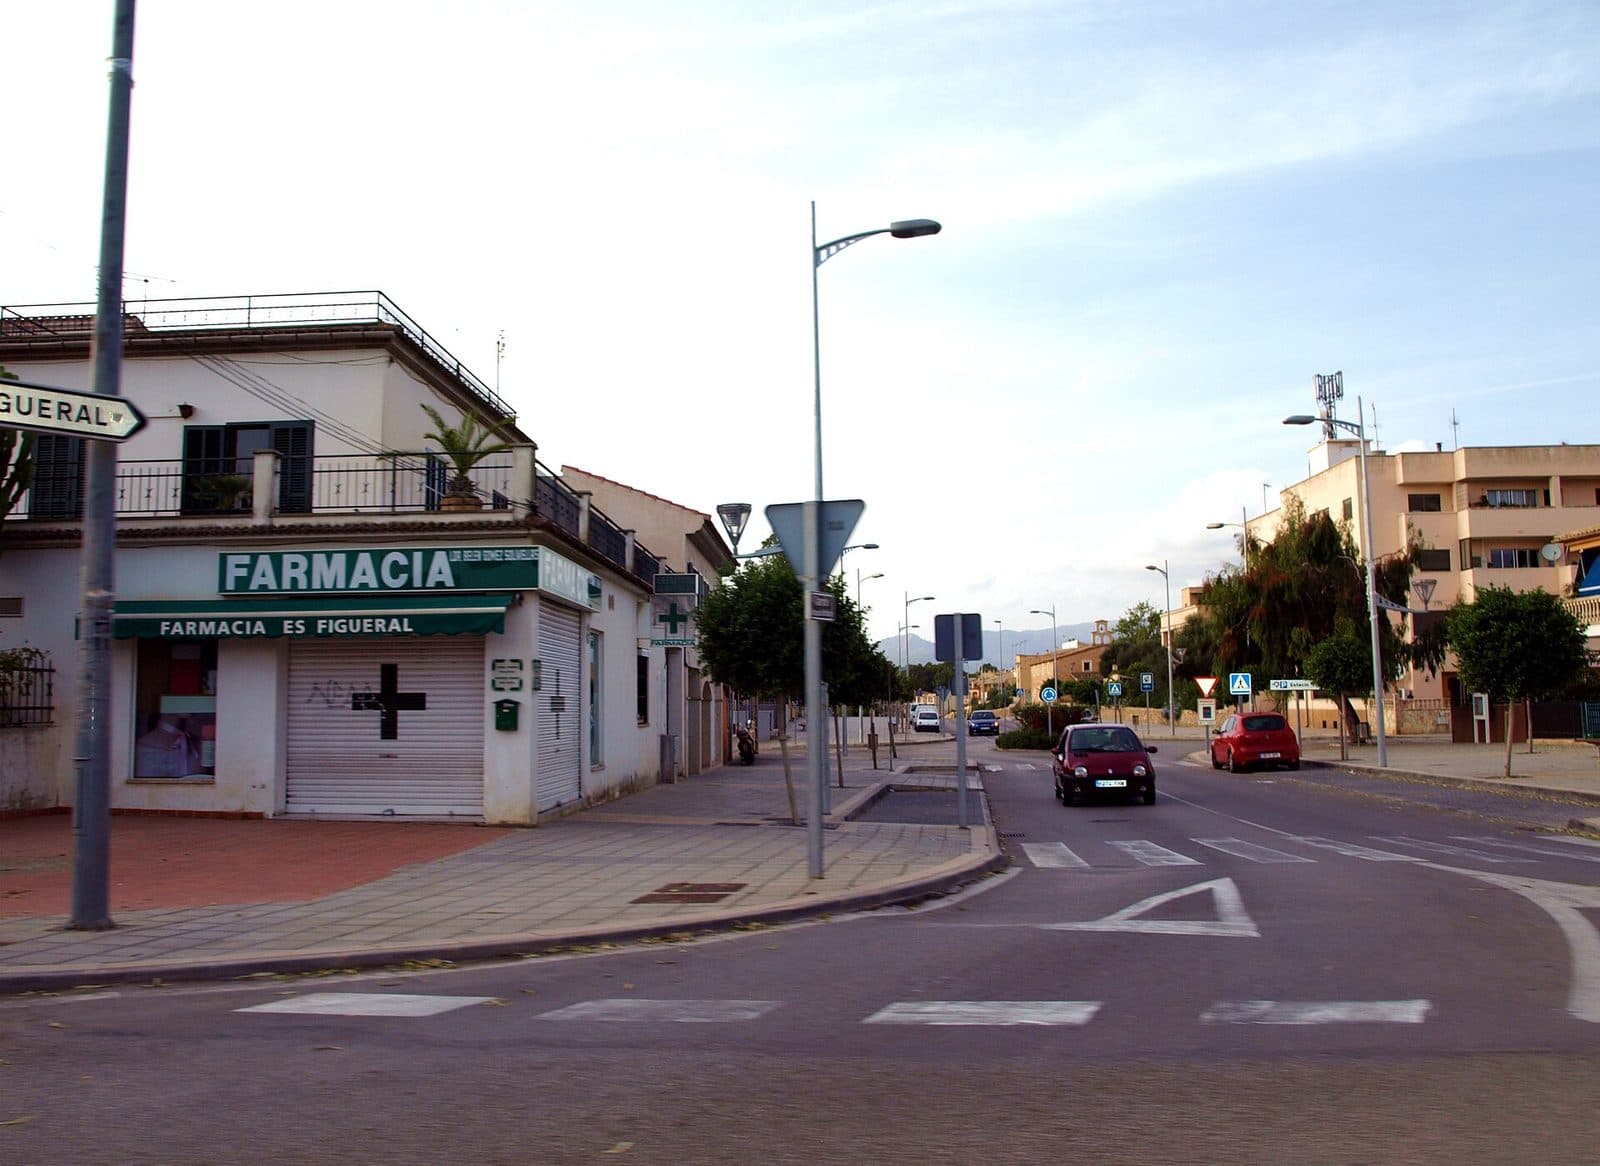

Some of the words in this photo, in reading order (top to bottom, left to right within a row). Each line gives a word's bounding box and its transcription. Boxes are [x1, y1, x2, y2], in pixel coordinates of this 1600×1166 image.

[225, 551, 455, 590] FARMACIA
[160, 621, 266, 635] FARMACIA
[283, 620, 305, 634] ES
[317, 618, 413, 633] FIGUERAL
